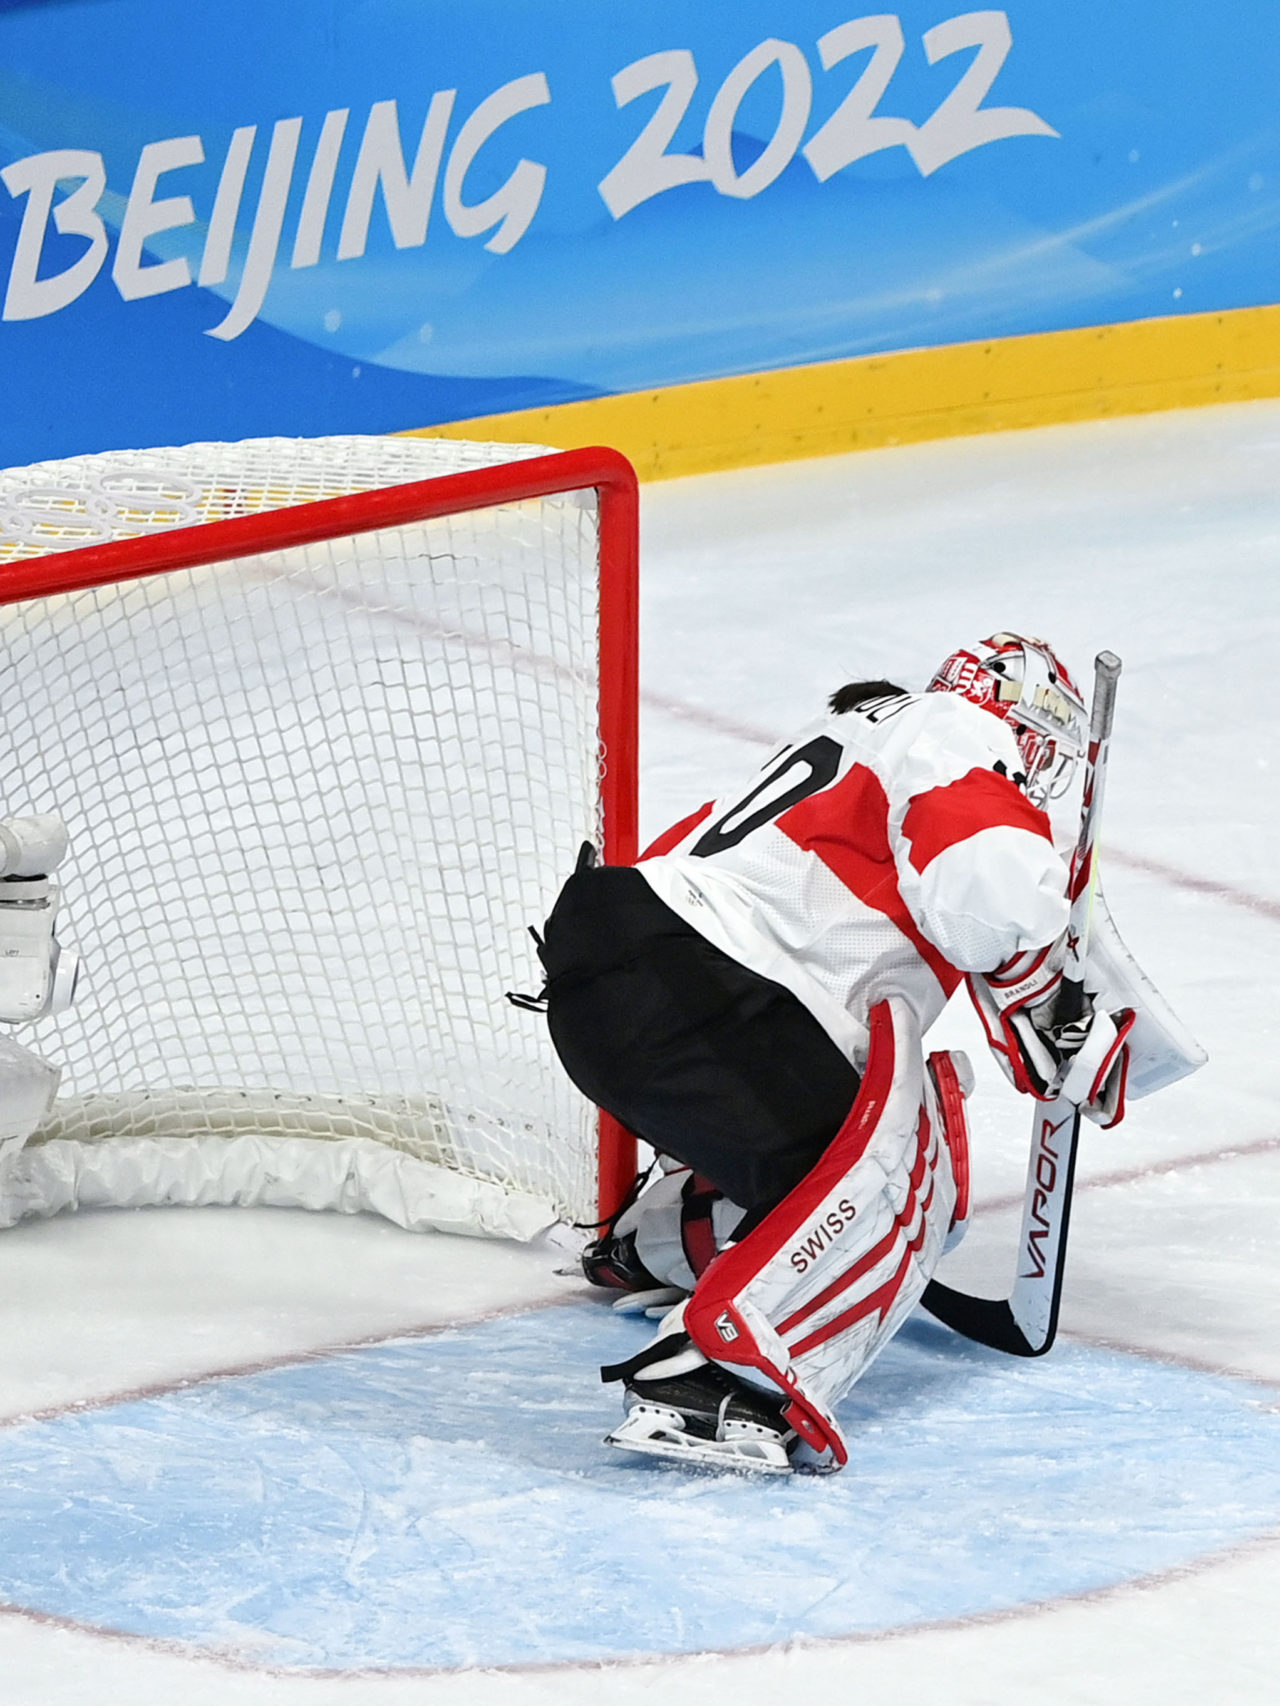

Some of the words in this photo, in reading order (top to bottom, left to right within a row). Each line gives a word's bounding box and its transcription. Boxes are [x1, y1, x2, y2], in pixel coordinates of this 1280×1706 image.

[0, 72, 551, 342] BEIJING
[597, 10, 1062, 221] 2022
[689, 735, 844, 858] 0
[790, 1199, 856, 1274] SWISS
[1019, 1113, 1074, 1278] VAPOR
